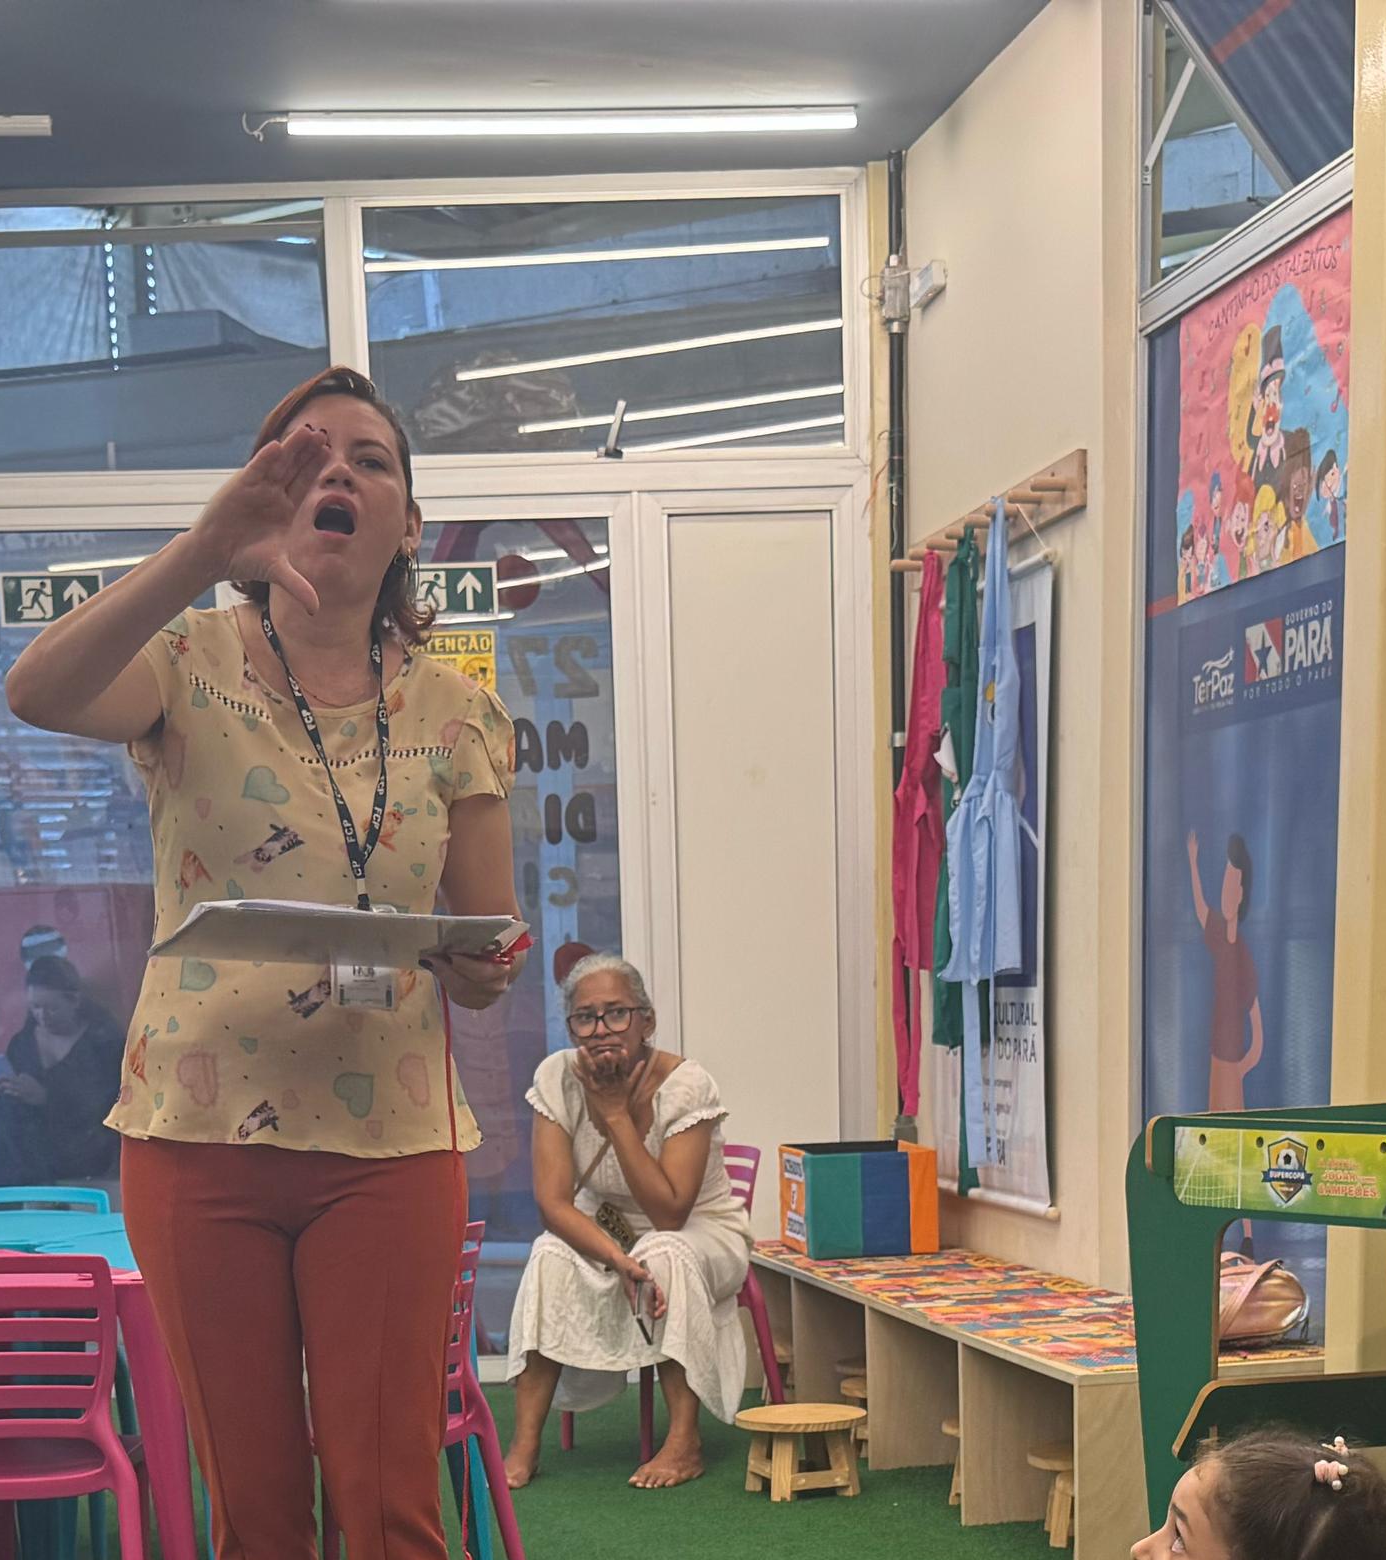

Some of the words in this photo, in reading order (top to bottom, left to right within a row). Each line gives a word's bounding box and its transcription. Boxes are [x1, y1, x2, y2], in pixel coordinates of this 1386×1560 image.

[1285, 604, 1319, 626] GOVERNO
[1192, 669, 1234, 704] TerPaz
[1013, 1033, 1038, 1064] PARÁ
